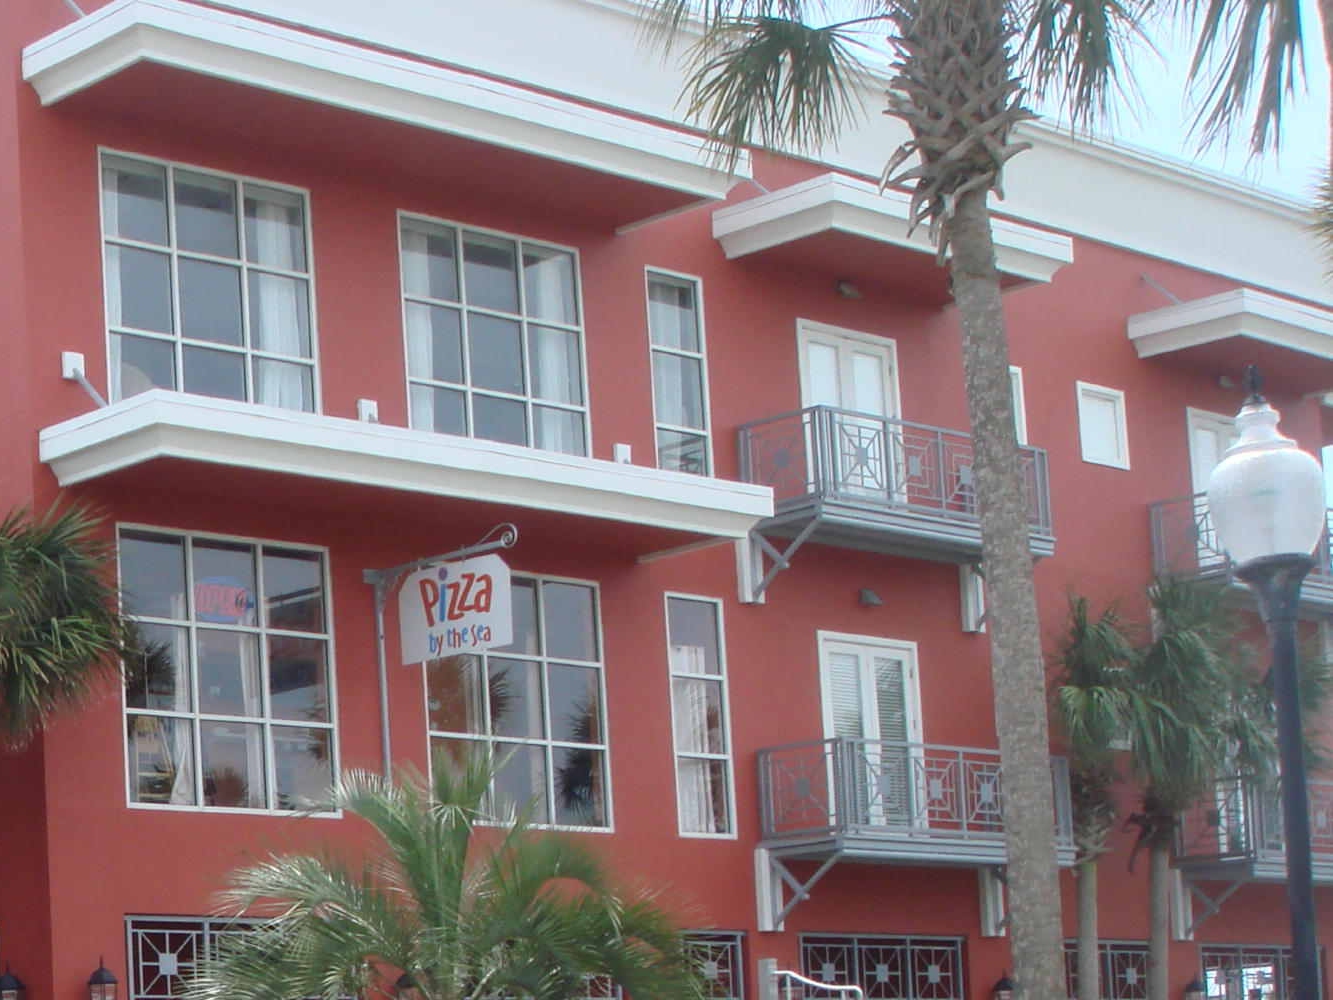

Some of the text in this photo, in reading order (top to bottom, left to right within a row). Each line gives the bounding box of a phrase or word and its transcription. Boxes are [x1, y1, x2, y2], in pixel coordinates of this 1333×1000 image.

[419, 567, 492, 628] Pizza
[429, 632, 444, 656] by
[447, 627, 468, 648] the
